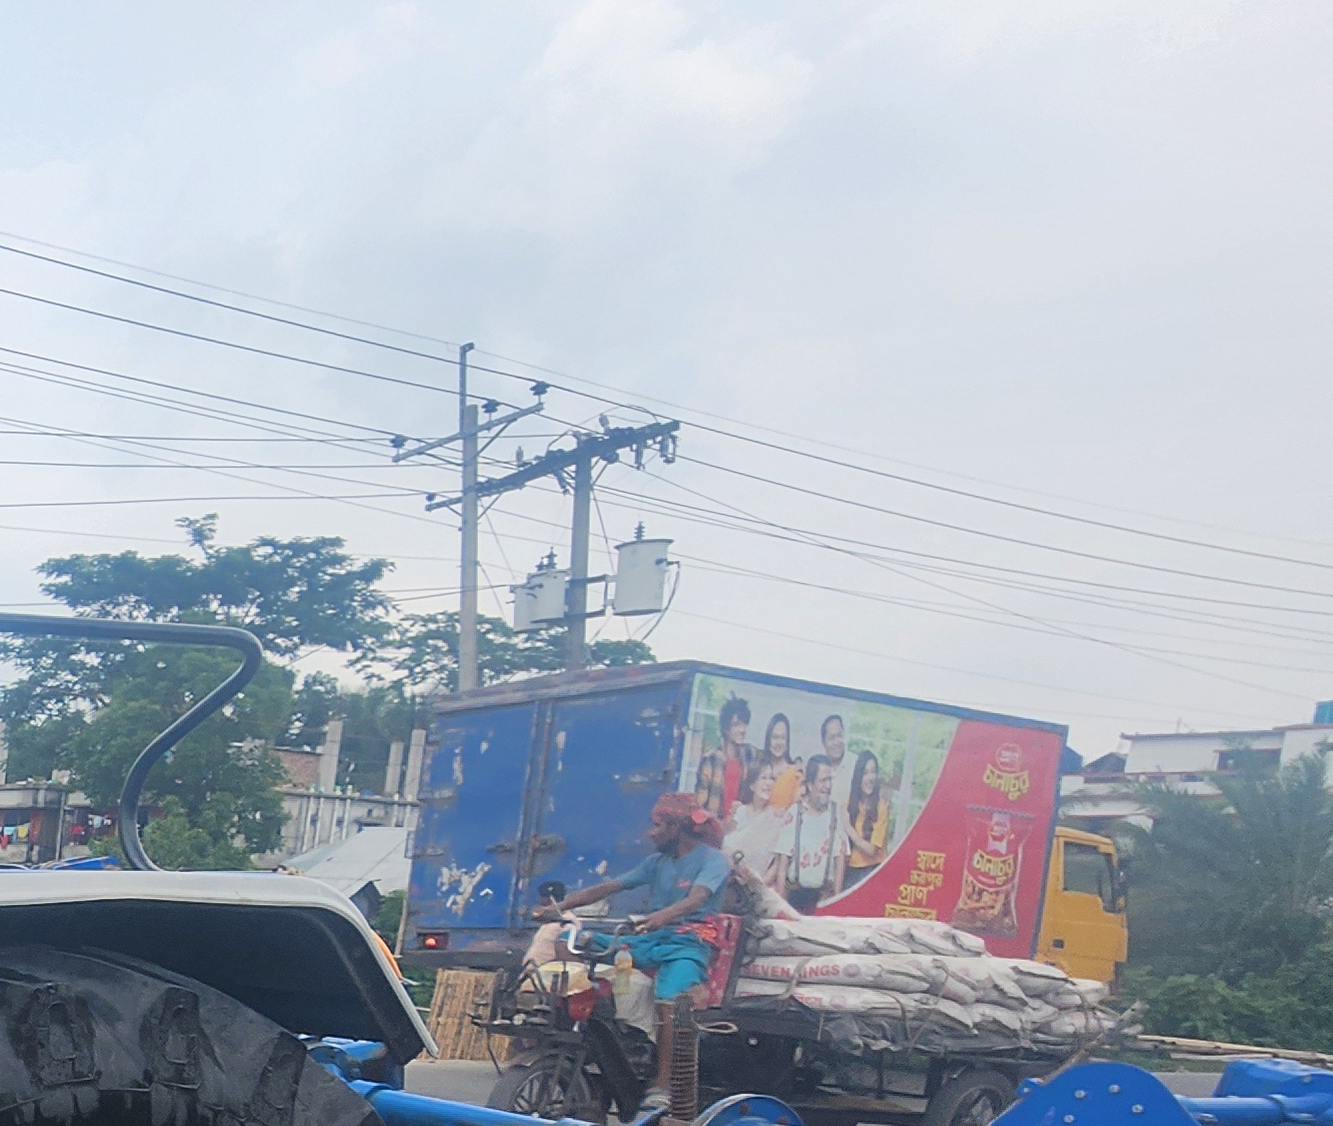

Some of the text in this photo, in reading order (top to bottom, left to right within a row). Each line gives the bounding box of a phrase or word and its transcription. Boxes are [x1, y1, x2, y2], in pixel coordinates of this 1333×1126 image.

[983, 763, 1029, 801] চানাচুর
[898, 884, 928, 906] প্রাণ
[796, 965, 840, 979] INGS
